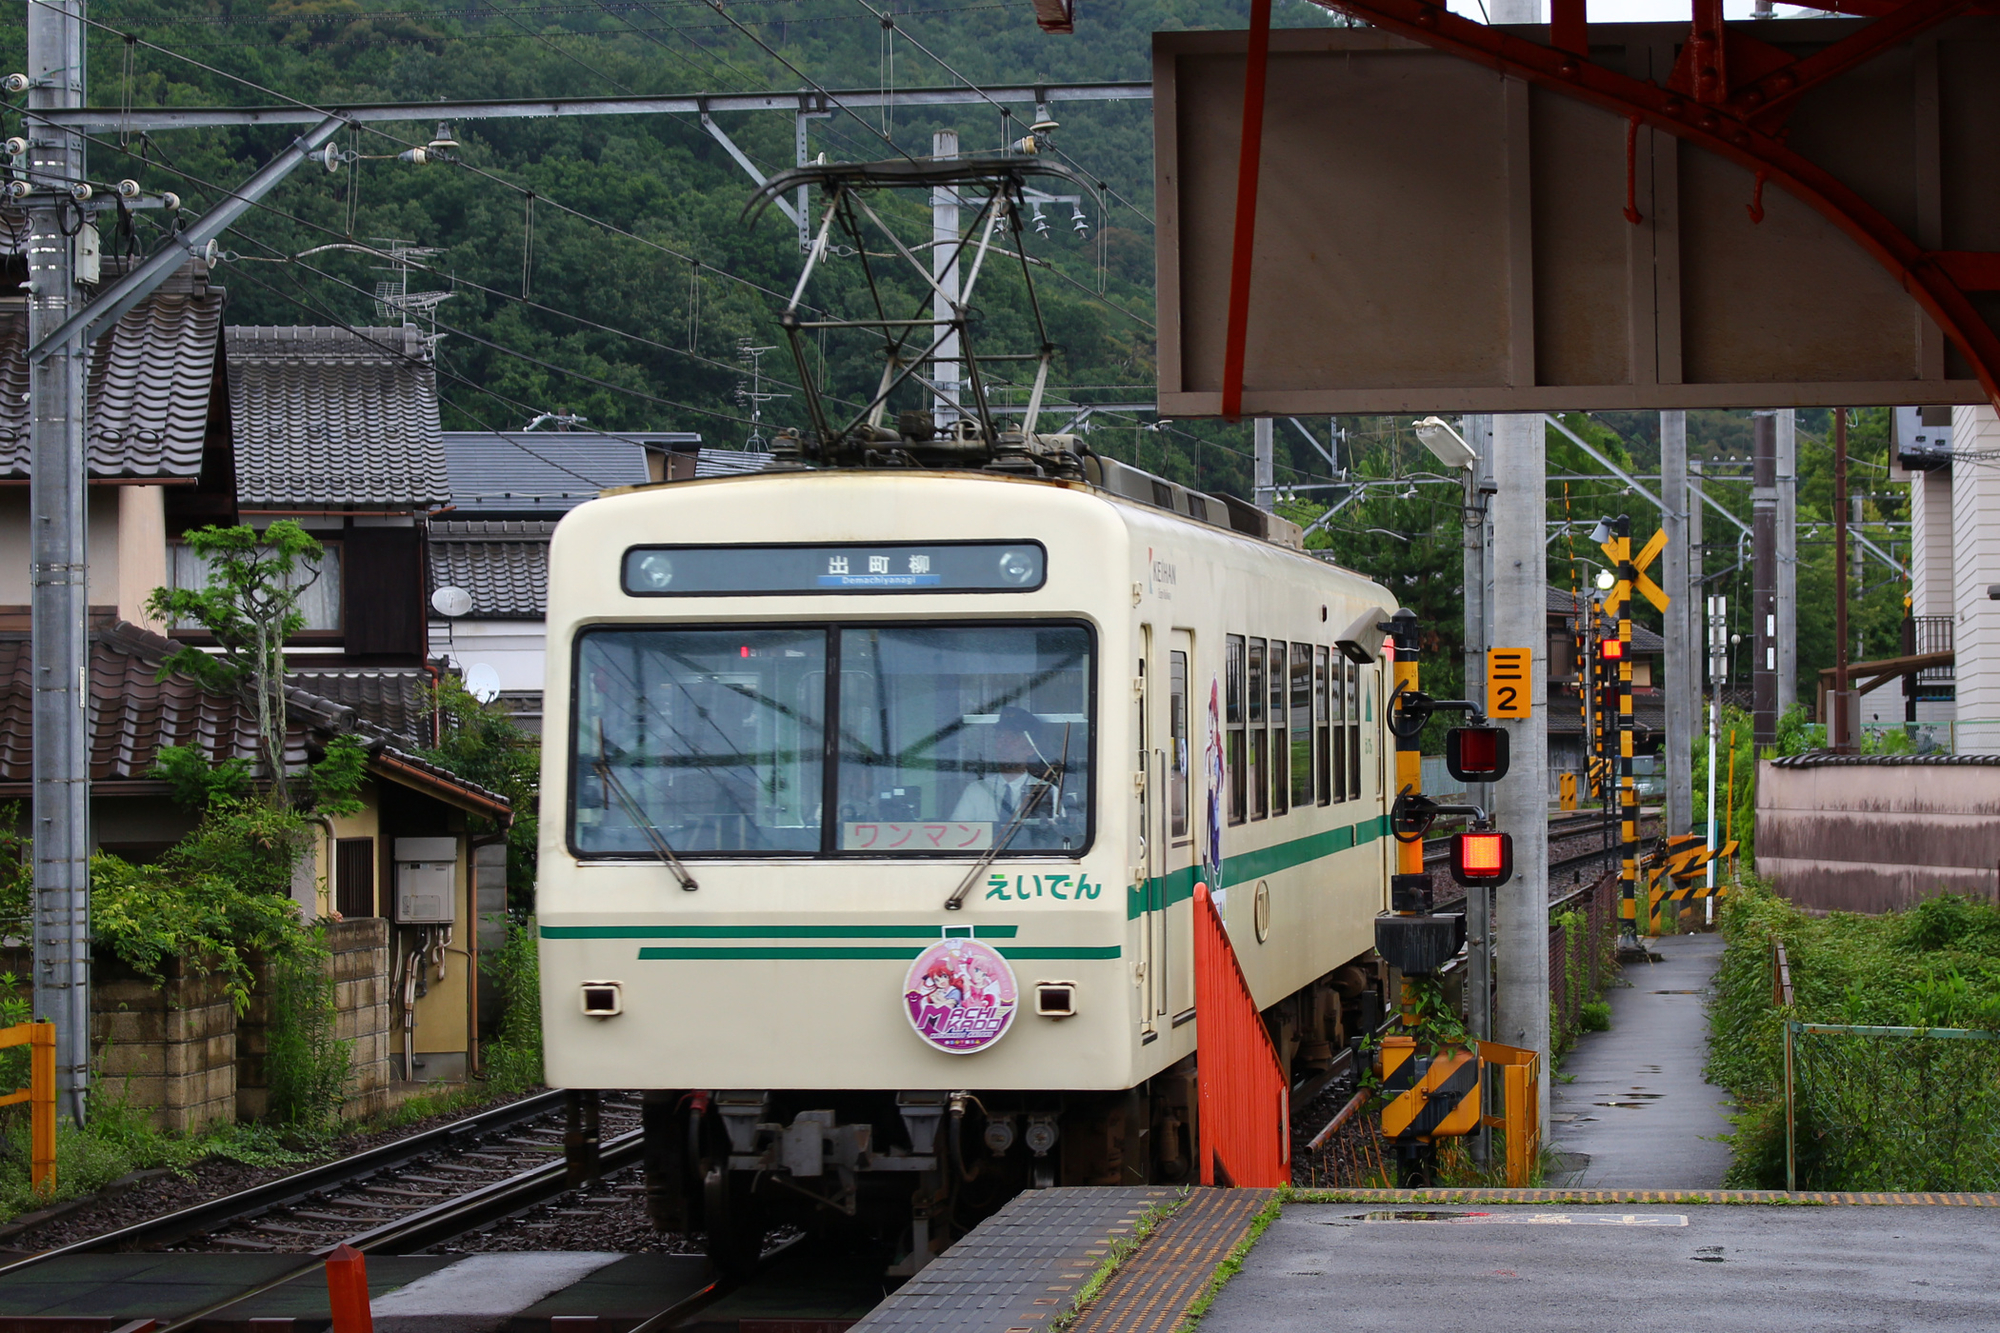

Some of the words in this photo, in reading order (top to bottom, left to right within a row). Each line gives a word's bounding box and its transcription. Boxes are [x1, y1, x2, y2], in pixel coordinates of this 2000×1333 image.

[828, 554, 930, 574] 出町柳
[1153, 560, 1176, 585] KEIHAN
[841, 576, 916, 585] Demachiyanagi
[1497, 686, 1518, 711] 2
[854, 824, 982, 849] ワンマン
[986, 873, 1102, 900] えいでん
